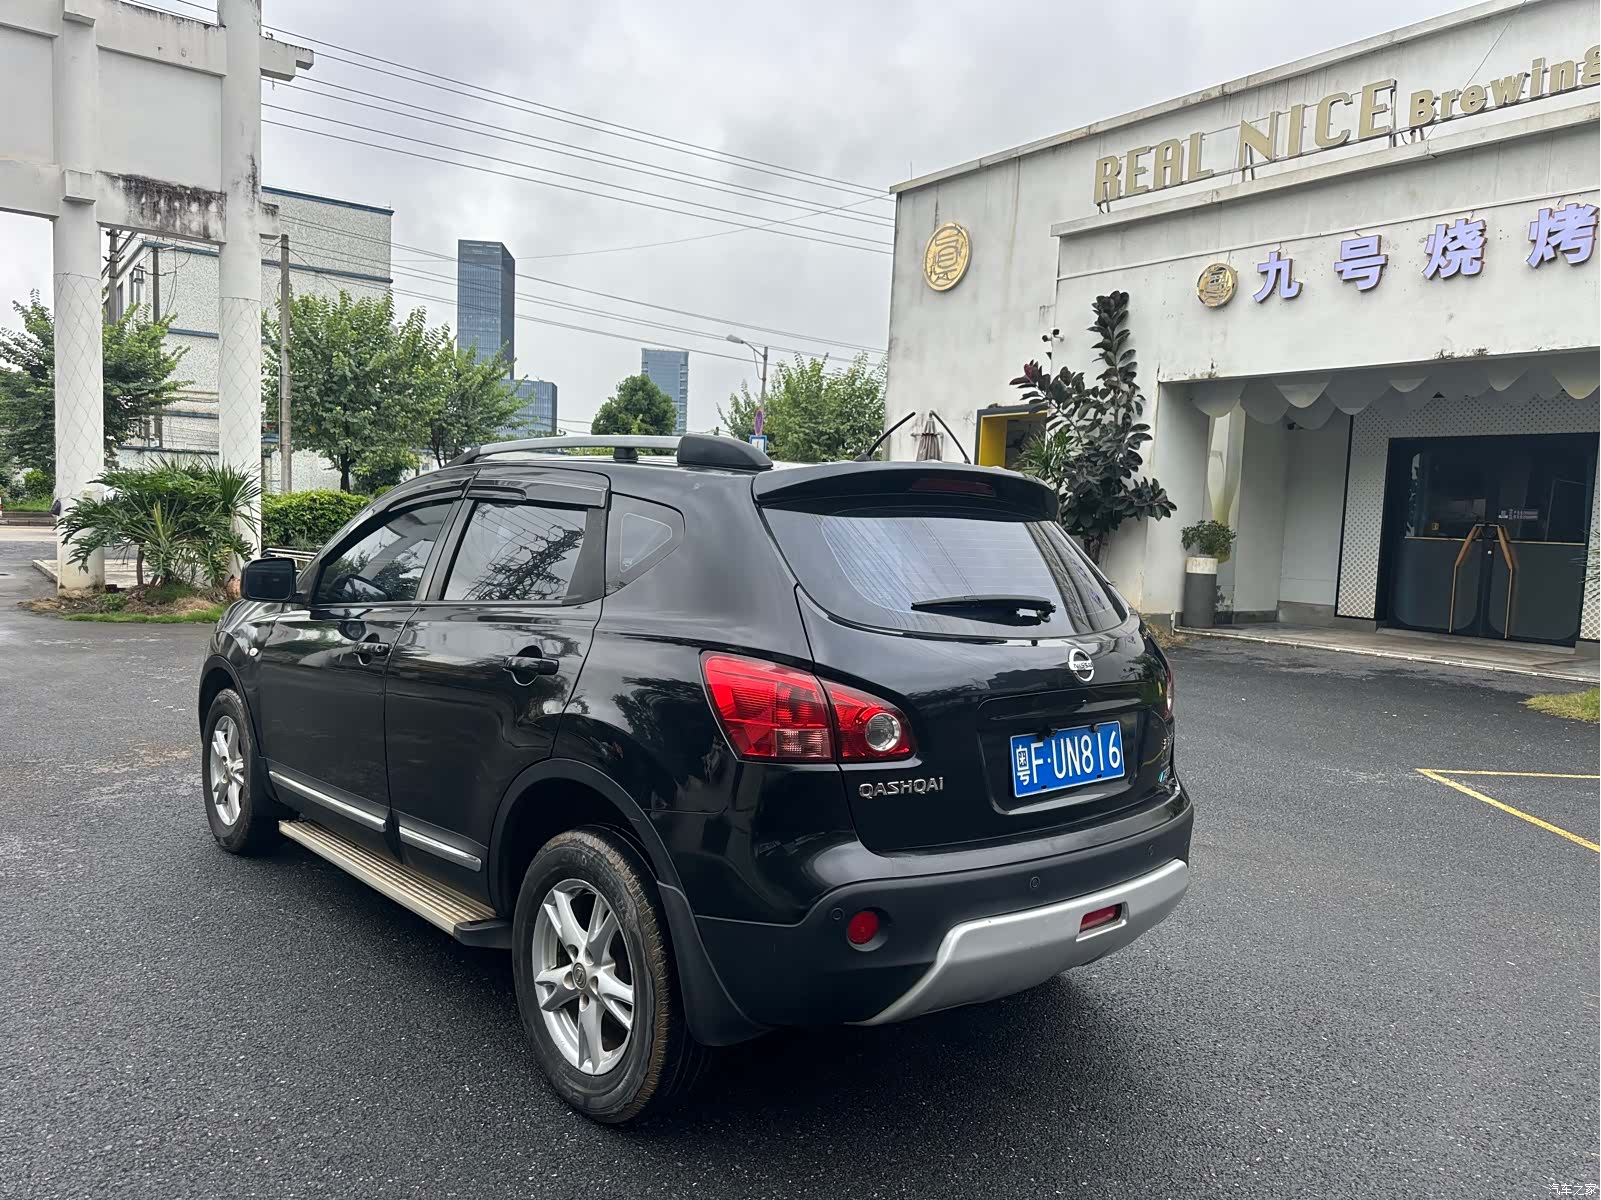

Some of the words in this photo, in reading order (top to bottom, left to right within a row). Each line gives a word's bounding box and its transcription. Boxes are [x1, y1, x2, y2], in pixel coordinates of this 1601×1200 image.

[1094, 132, 1213, 205] REAL
[1238, 79, 1397, 161] NICE
[1408, 44, 1600, 128] Brewing
[1253, 203, 1599, 304] 九号烧烤
[1016, 731, 1121, 786] 粤F·UN816
